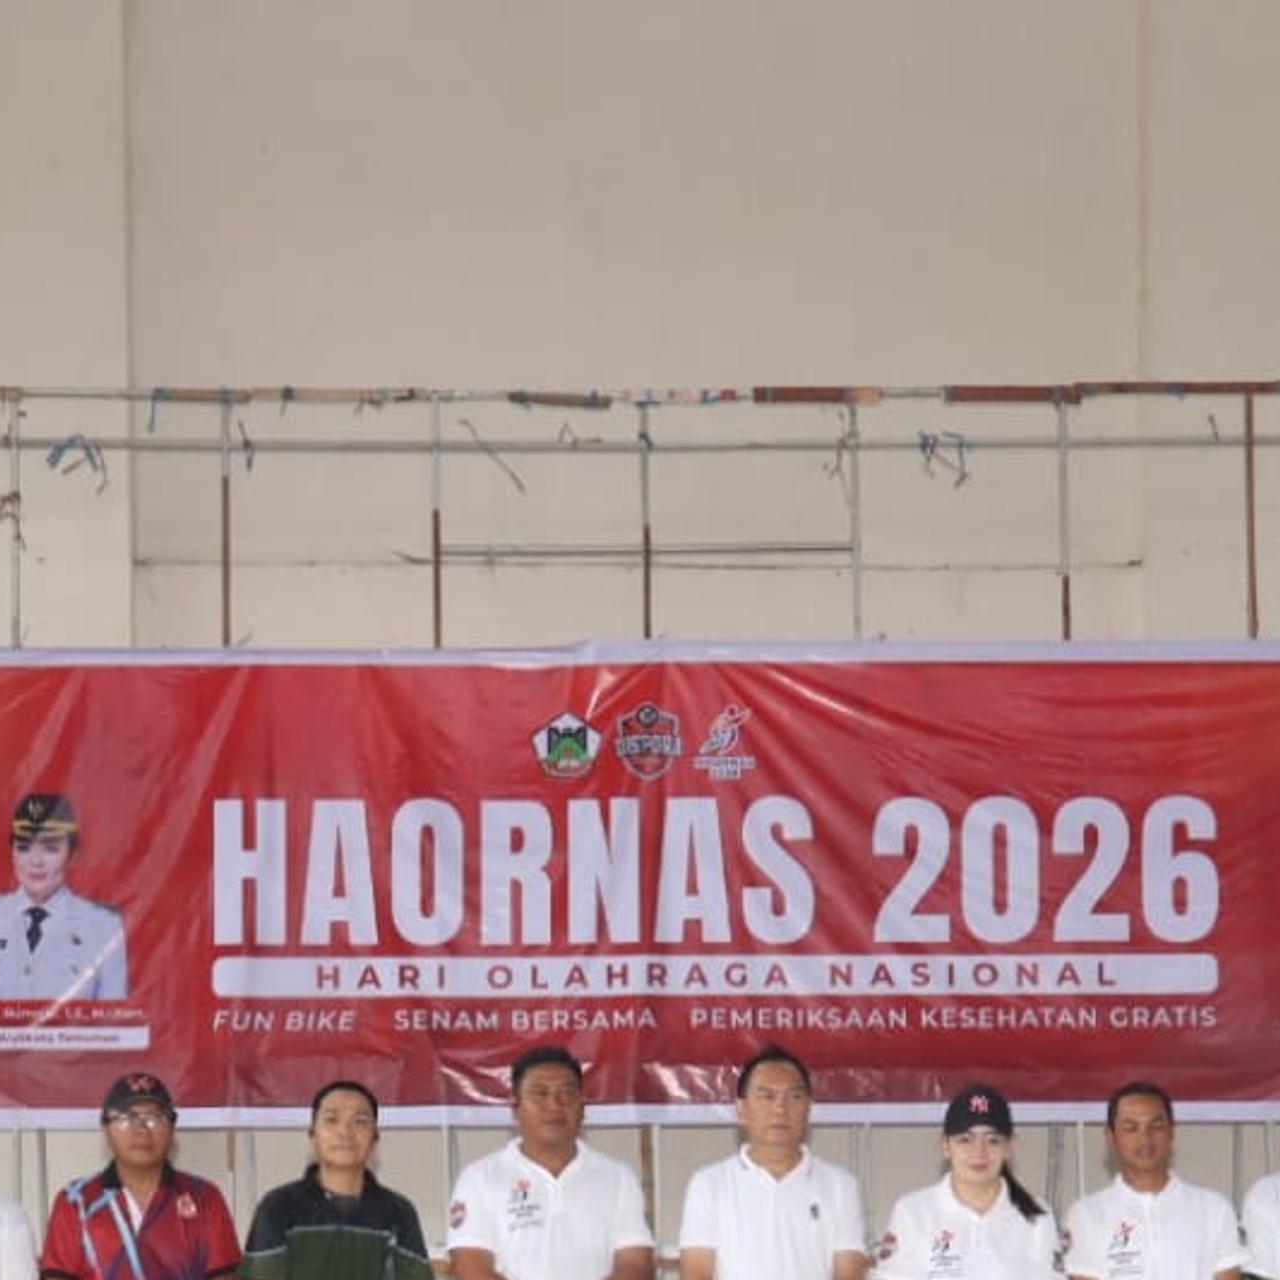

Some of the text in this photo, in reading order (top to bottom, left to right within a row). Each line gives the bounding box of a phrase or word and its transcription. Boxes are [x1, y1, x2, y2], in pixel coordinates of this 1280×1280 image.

[213, 794, 1220, 946] HAORNAS 2026
[316, 961, 1116, 990] HARI OLAHRAGA NASIONAL
[213, 1010, 357, 1031] FUN BIKE
[393, 1007, 658, 1031] SENAM BERSAMA
[690, 1006, 1218, 1030] PEMERIKSAAN KESEHATAN GRATIS
